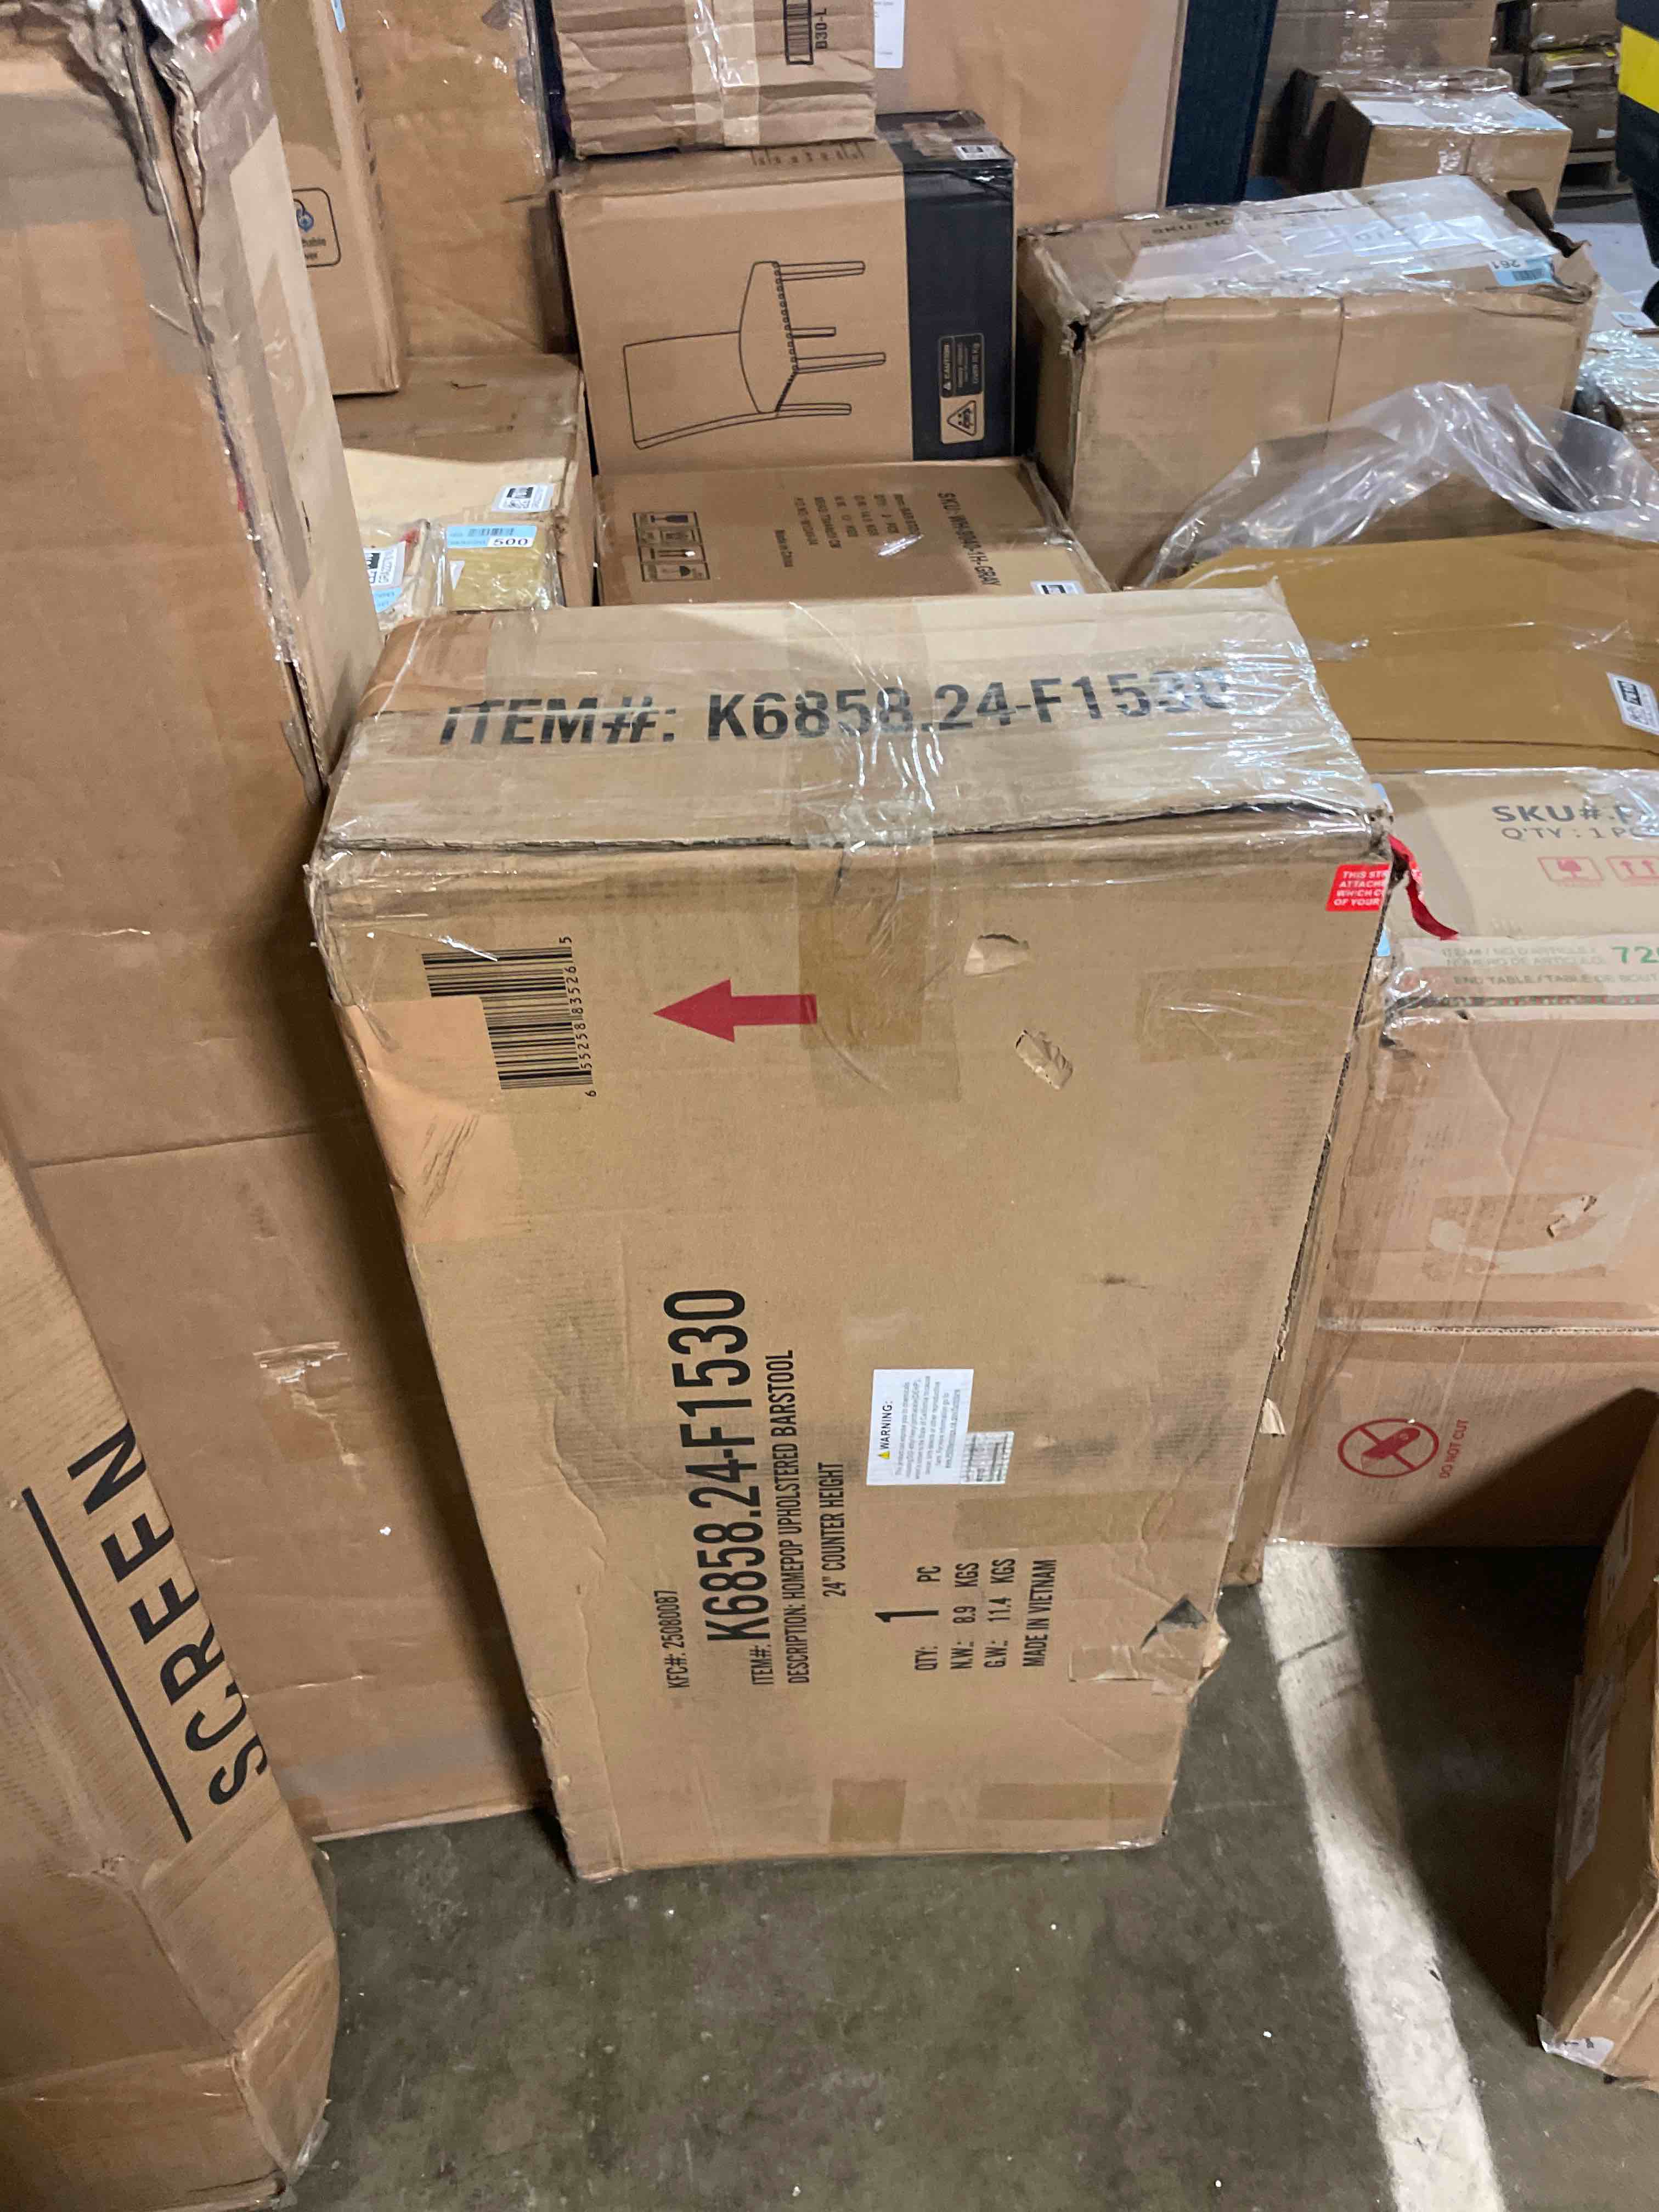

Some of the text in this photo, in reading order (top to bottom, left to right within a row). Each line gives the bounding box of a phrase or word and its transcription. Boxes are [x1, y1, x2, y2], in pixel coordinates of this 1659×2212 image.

[440, 696, 676, 744] ITEM#:
[879, 1401, 893, 1450] WARNING:
[1452, 1419, 1470, 1441] CUT
[663, 1289, 774, 1685] ITEM#: K6858.24-F1530
[817, 1462, 844, 1508] HEIGHT
[765, 1349, 810, 1684] DESCRIPTION: HOMEPOP UPHOLSTERED BARSTOOL
[820, 1513, 846, 1571] COUNTER
[955, 1562, 979, 1587] KGS
[990, 1558, 1015, 1584] KGS
[67, 1422, 268, 1805] SCREEN
[654, 1589, 685, 1649] 25080087
[874, 1566, 941, 1671] QTY: 1 PC
[952, 1606, 976, 1624] 8.9
[989, 1598, 1012, 1622] 11.4
[1023, 1559, 1057, 1667] MADE IN VIETNAM
